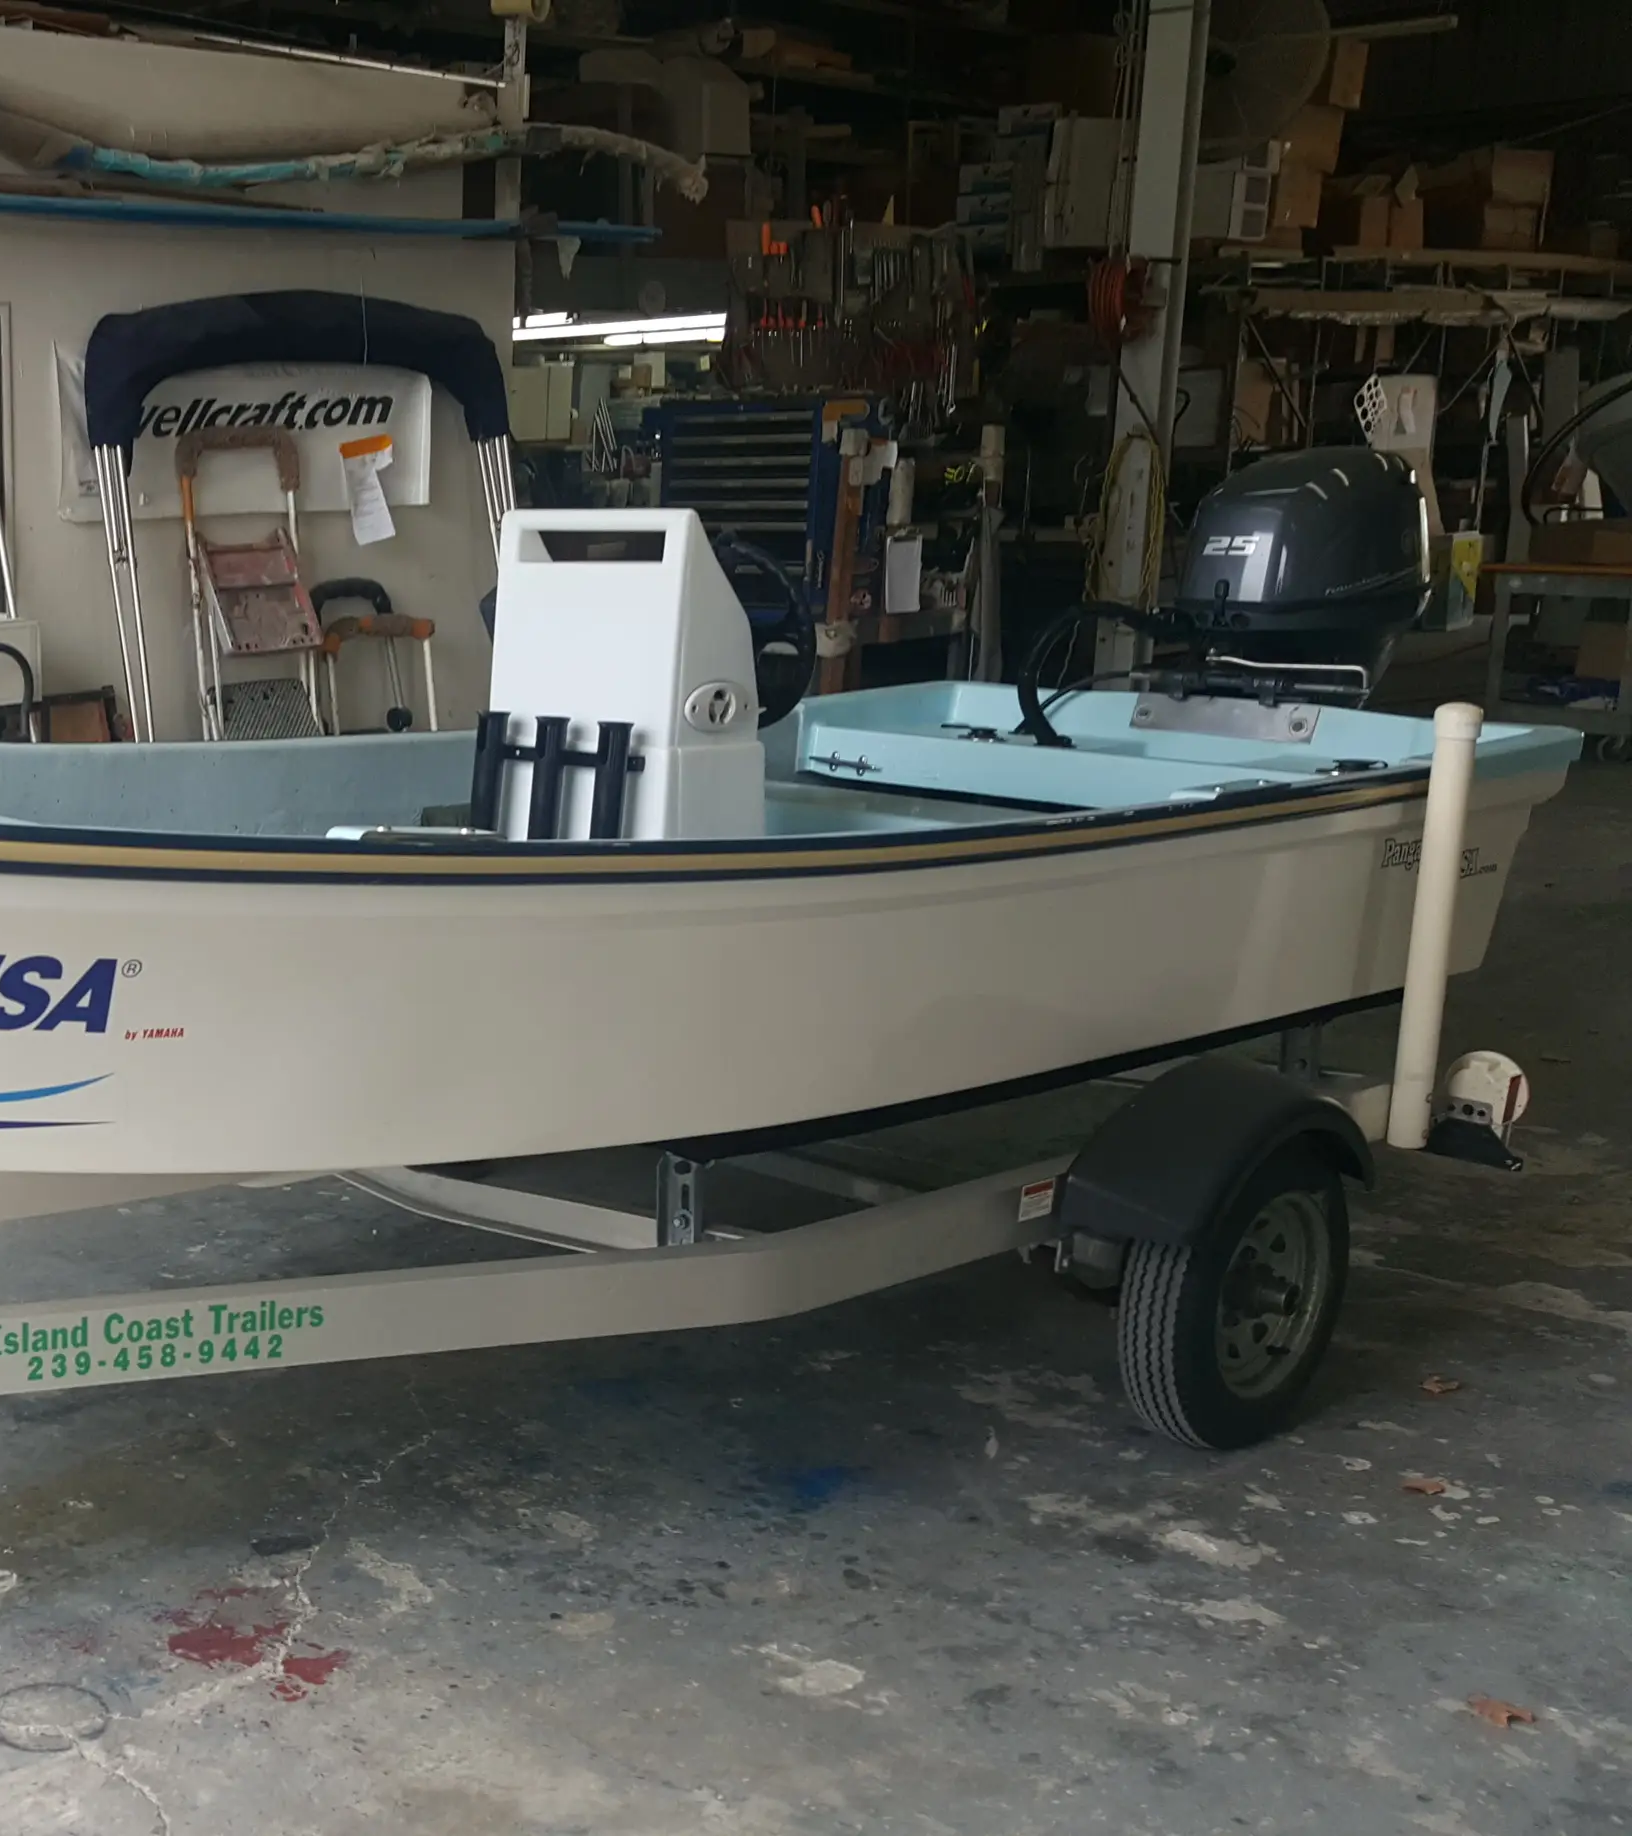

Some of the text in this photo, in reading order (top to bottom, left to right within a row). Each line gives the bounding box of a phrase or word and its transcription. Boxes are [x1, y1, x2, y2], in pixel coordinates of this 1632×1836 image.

[1203, 535, 1260, 556] 25
[124, 1027, 184, 1041] by YAMAHA
[103, 1308, 194, 1345] Coast
[208, 1300, 324, 1335] Trailers
[27, 1334, 283, 1381] 239-458-9442
